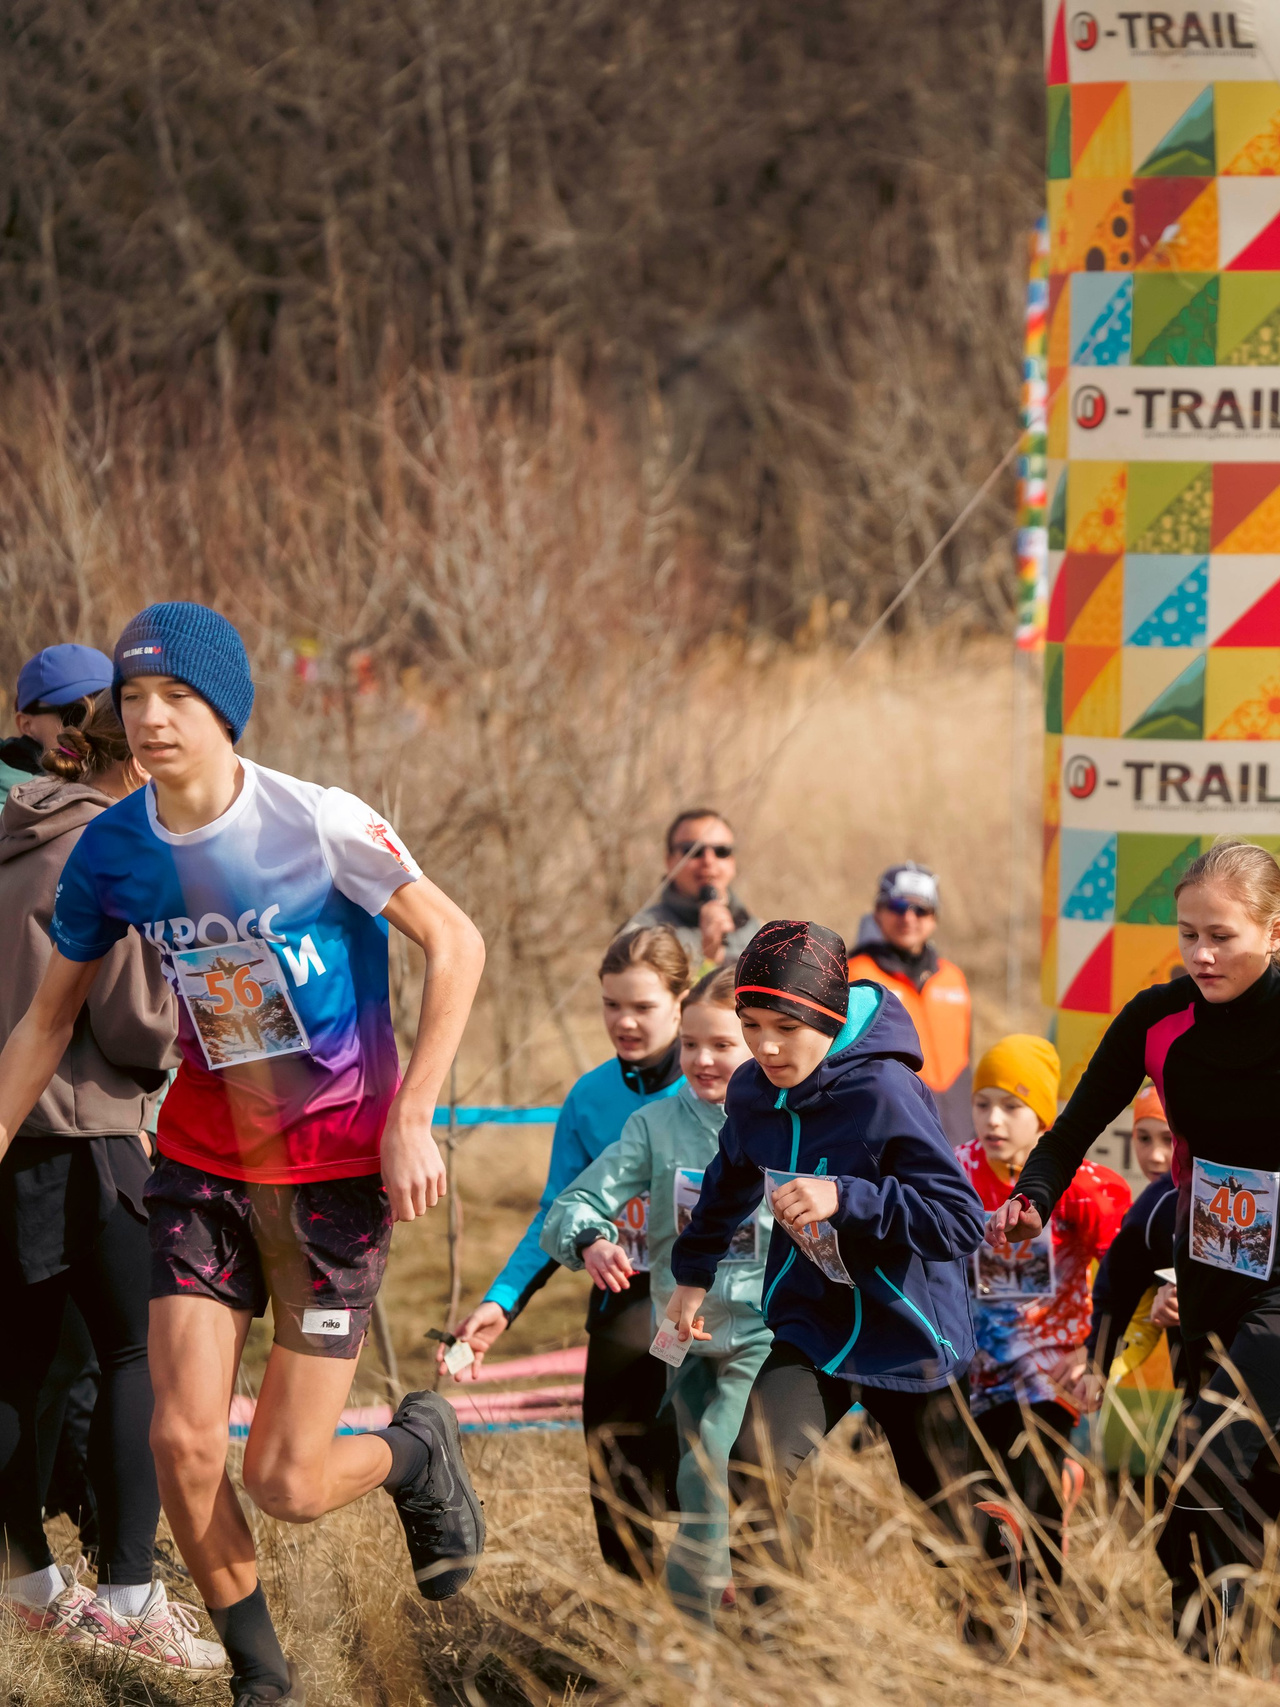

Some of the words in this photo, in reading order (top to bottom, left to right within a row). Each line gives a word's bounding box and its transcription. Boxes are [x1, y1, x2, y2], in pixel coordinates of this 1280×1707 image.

[143, 903, 287, 956] КРОСС
[205, 966, 264, 1015] 56
[1209, 1186, 1257, 1228] 40
